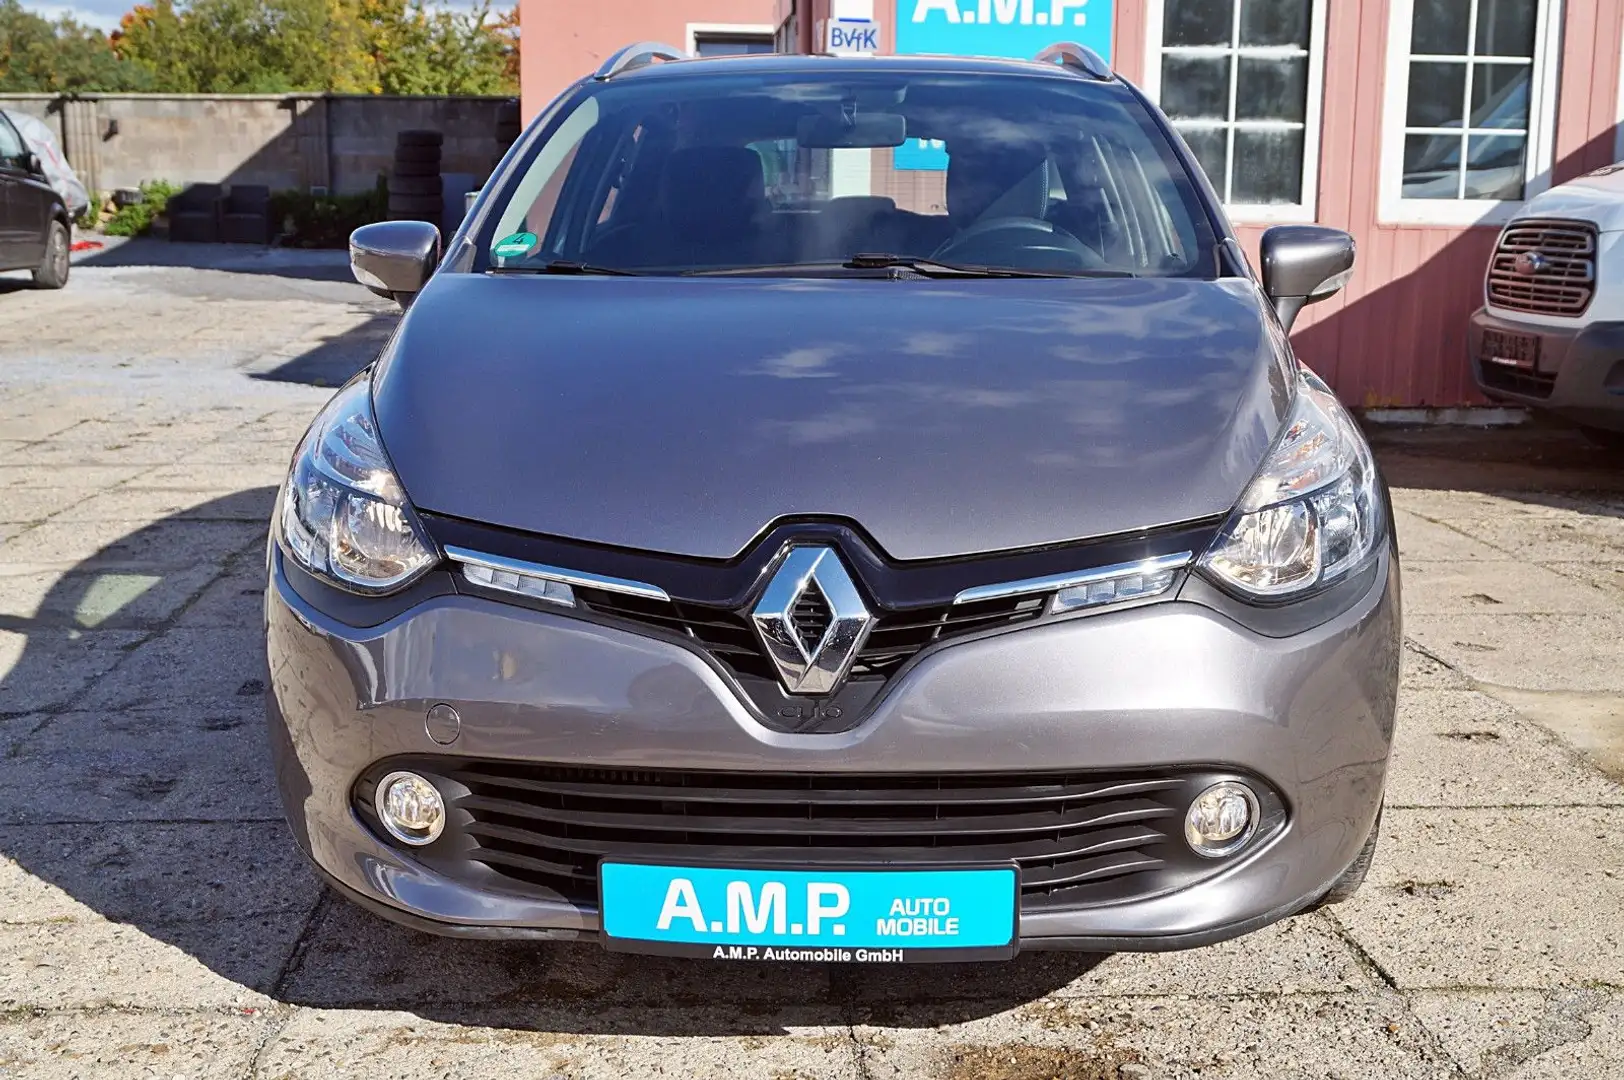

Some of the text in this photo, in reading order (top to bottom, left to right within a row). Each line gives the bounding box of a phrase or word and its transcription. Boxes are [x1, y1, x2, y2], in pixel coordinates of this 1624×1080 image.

[512, 233, 526, 244] 4
[656, 878, 850, 936] A.M.P.
[889, 897, 950, 916] AUTO
[876, 917, 959, 936] MOBILE
[712, 945, 904, 963] A.M.P. Automobile GmbH
